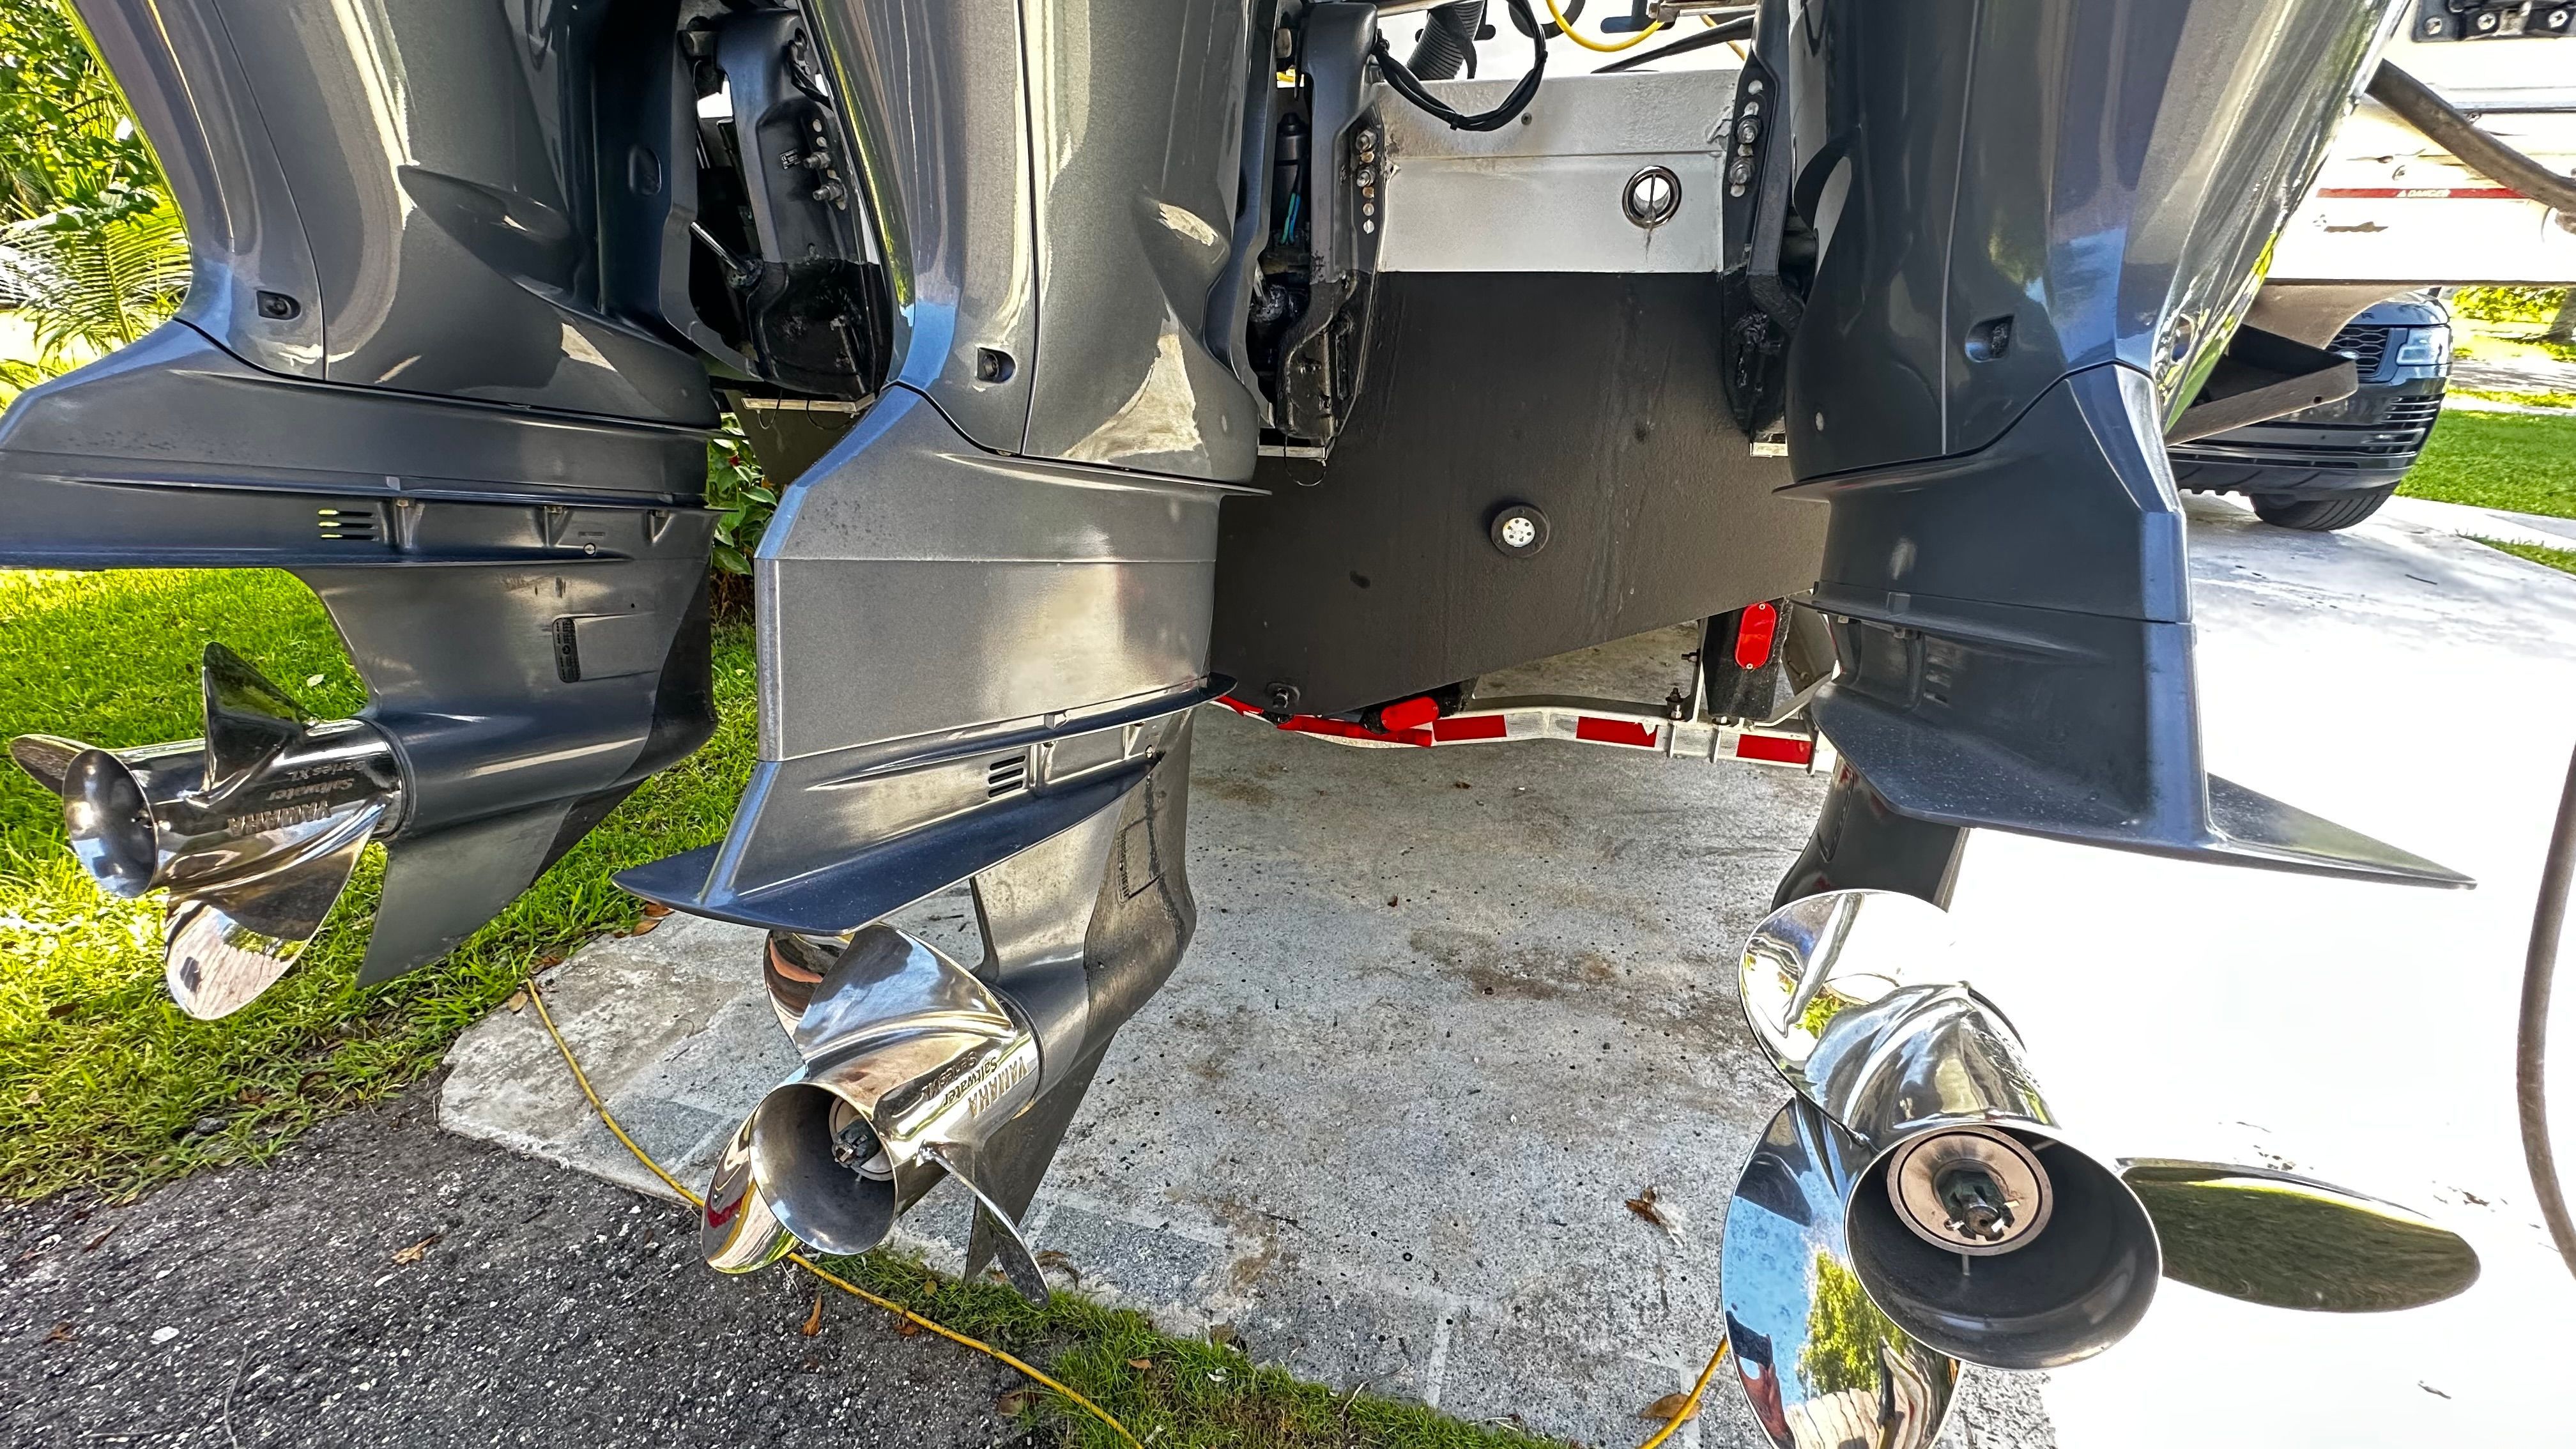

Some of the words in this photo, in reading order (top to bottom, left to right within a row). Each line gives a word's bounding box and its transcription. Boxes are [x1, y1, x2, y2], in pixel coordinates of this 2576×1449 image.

[268, 778, 354, 801] Saltwater
[227, 800, 332, 837] YAMAHA
[943, 1057, 997, 1107] Saltwater
[968, 1056, 1029, 1118] YAMAHA
